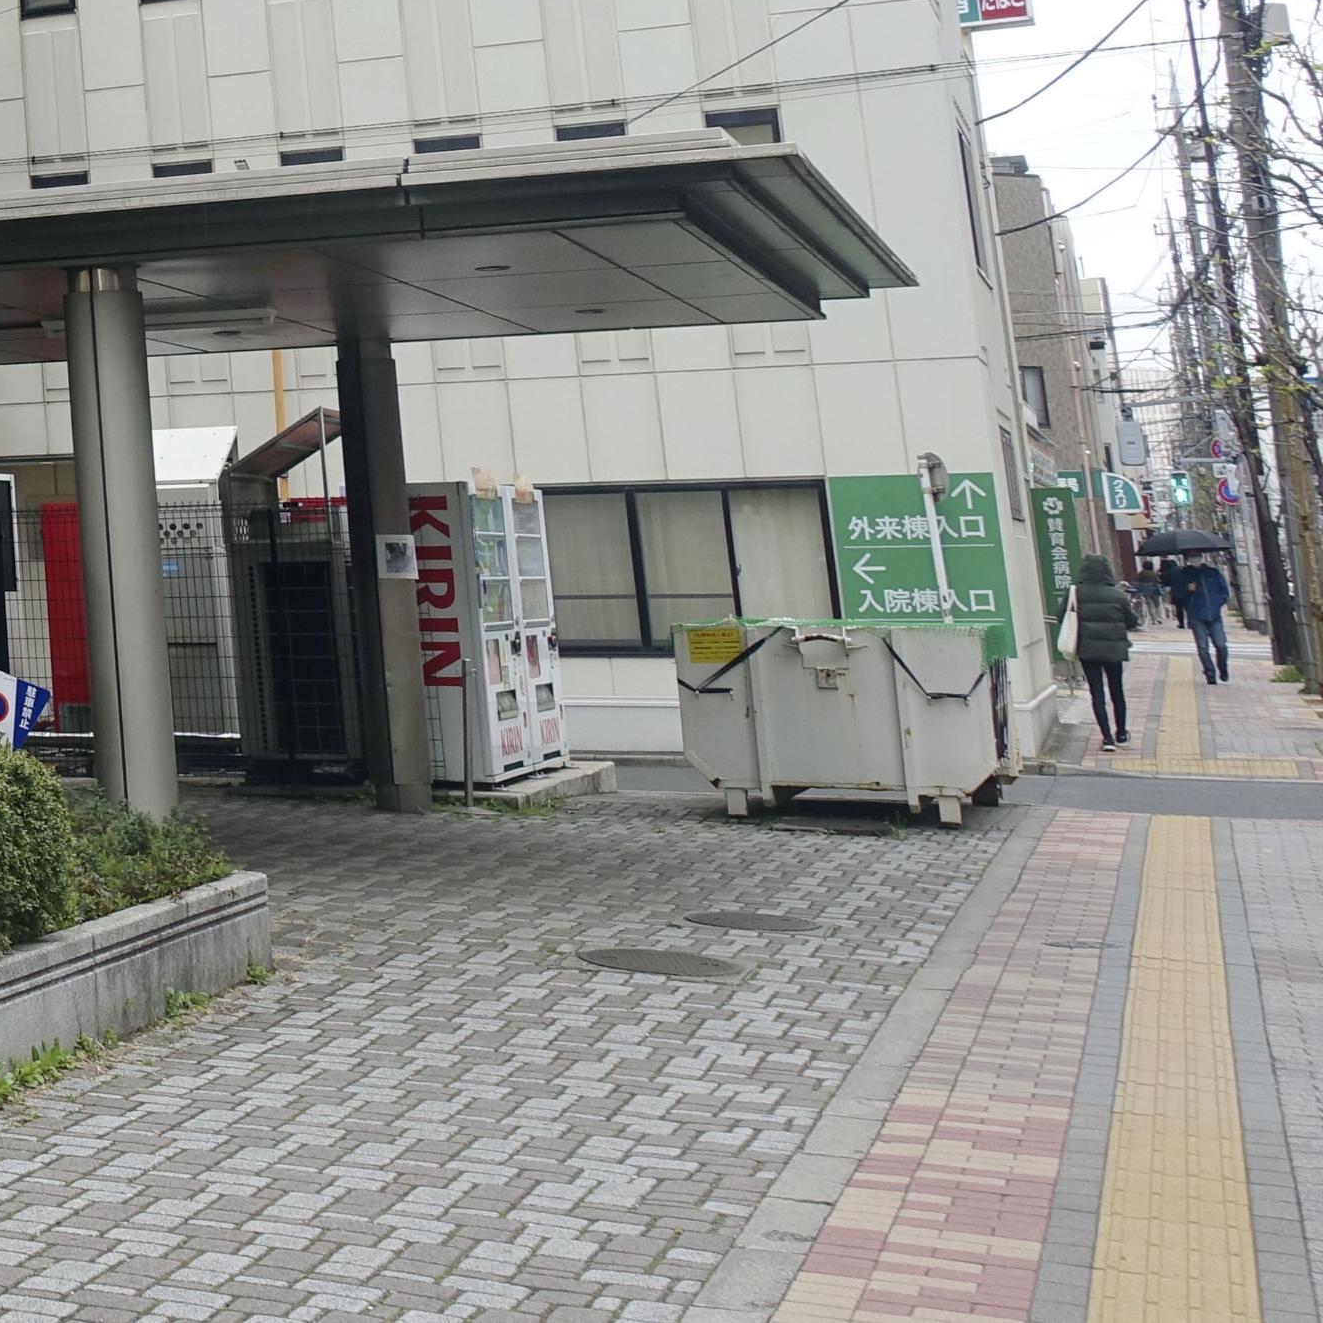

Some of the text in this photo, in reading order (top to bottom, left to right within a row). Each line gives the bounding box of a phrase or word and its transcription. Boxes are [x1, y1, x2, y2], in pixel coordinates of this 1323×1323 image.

[1113, 479, 1128, 508] クスリ
[1047, 517, 1072, 589] 賛育会病院
[409, 494, 465, 687] KIRIN
[19, 685, 38, 730] 駐車禁止
[500, 725, 523, 758] KIRIN
[539, 717, 560, 747] KIRIN
